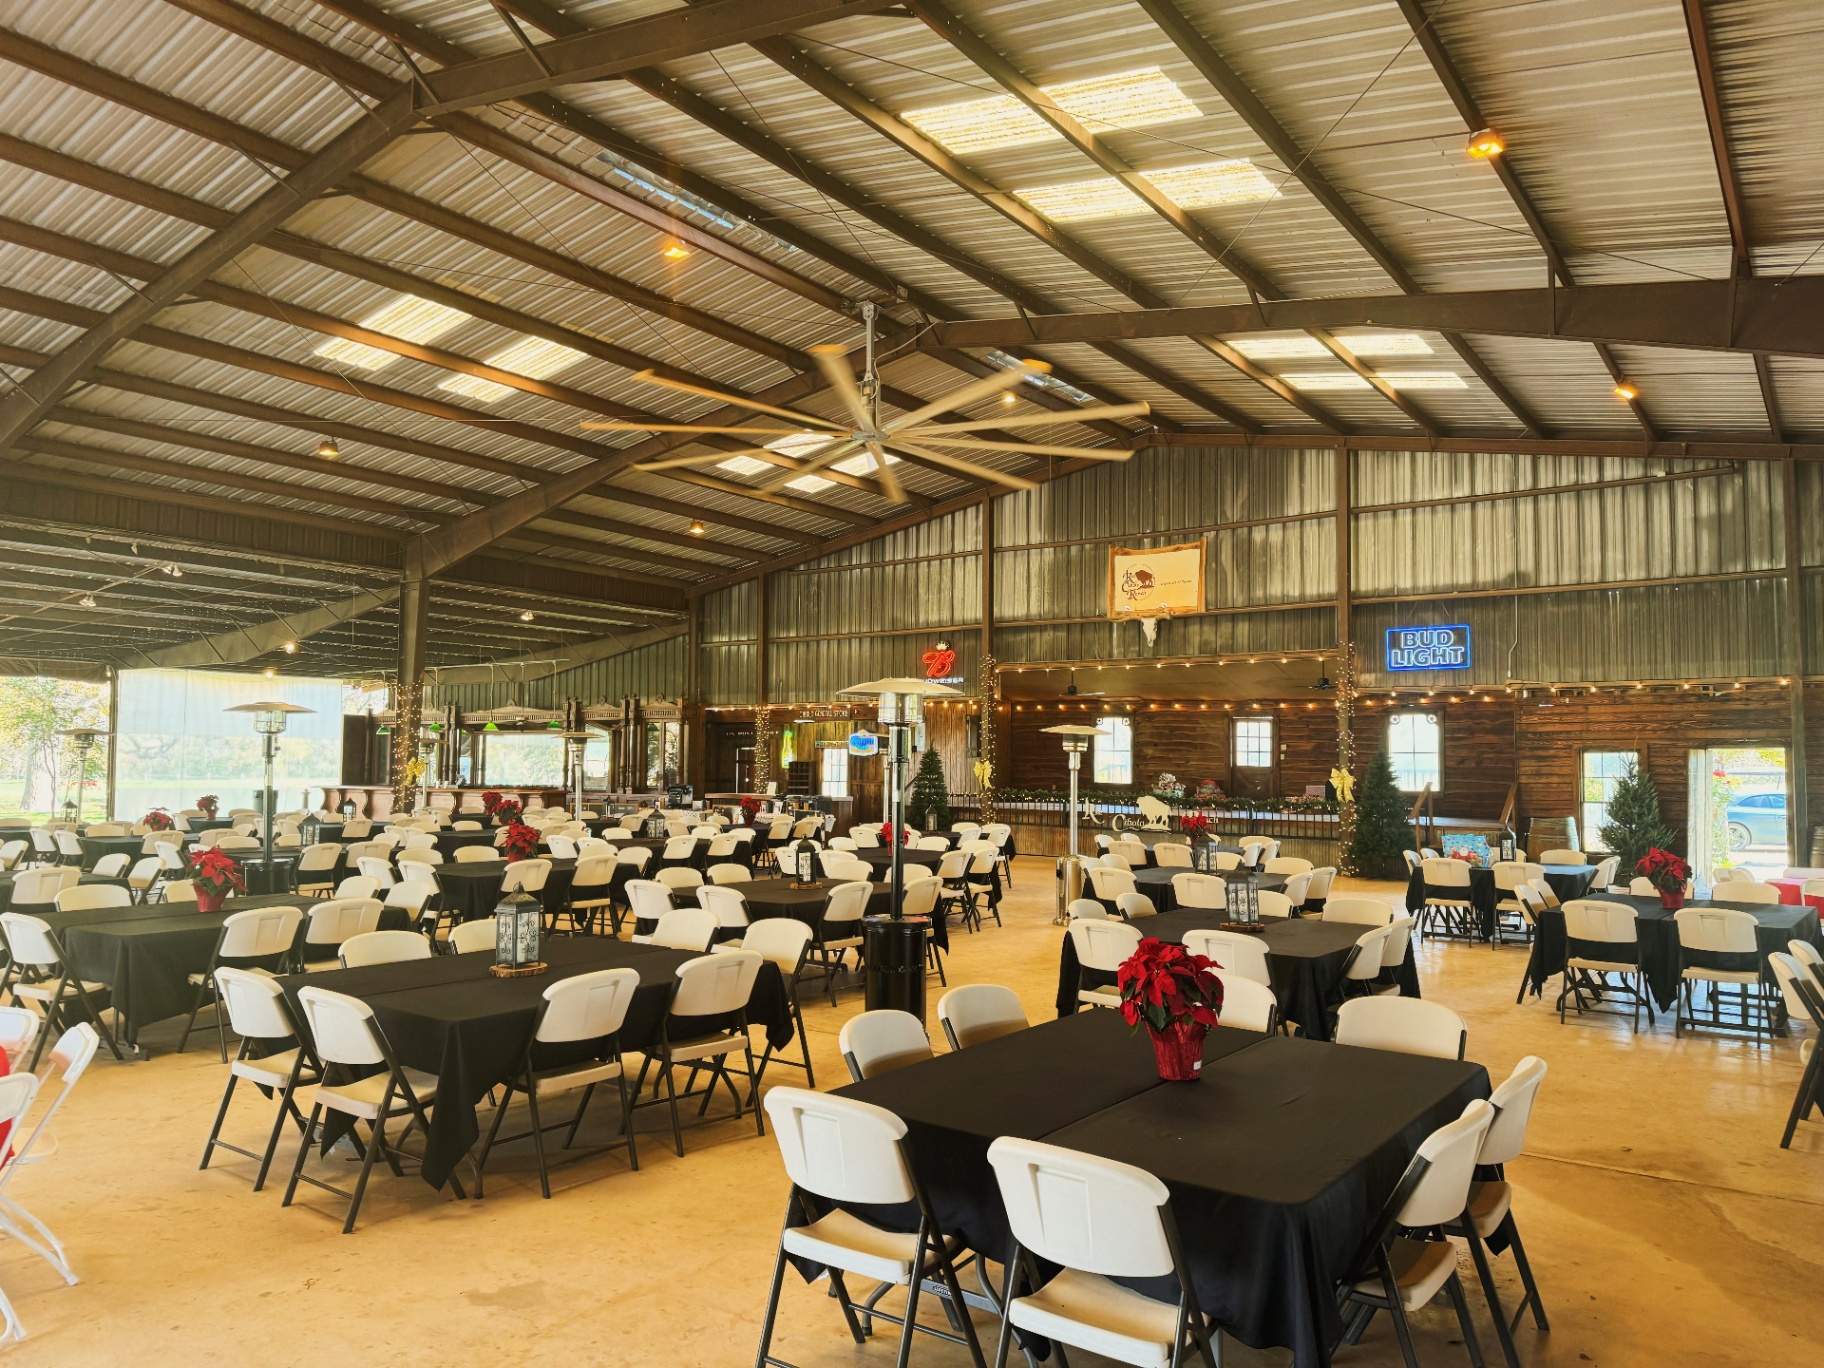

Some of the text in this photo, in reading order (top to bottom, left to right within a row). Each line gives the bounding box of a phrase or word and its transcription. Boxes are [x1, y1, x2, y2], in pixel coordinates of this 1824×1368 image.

[1401, 629, 1454, 648] BUD
[1391, 646, 1465, 667] LIGHT
[1111, 813, 1145, 832] Cibolo
